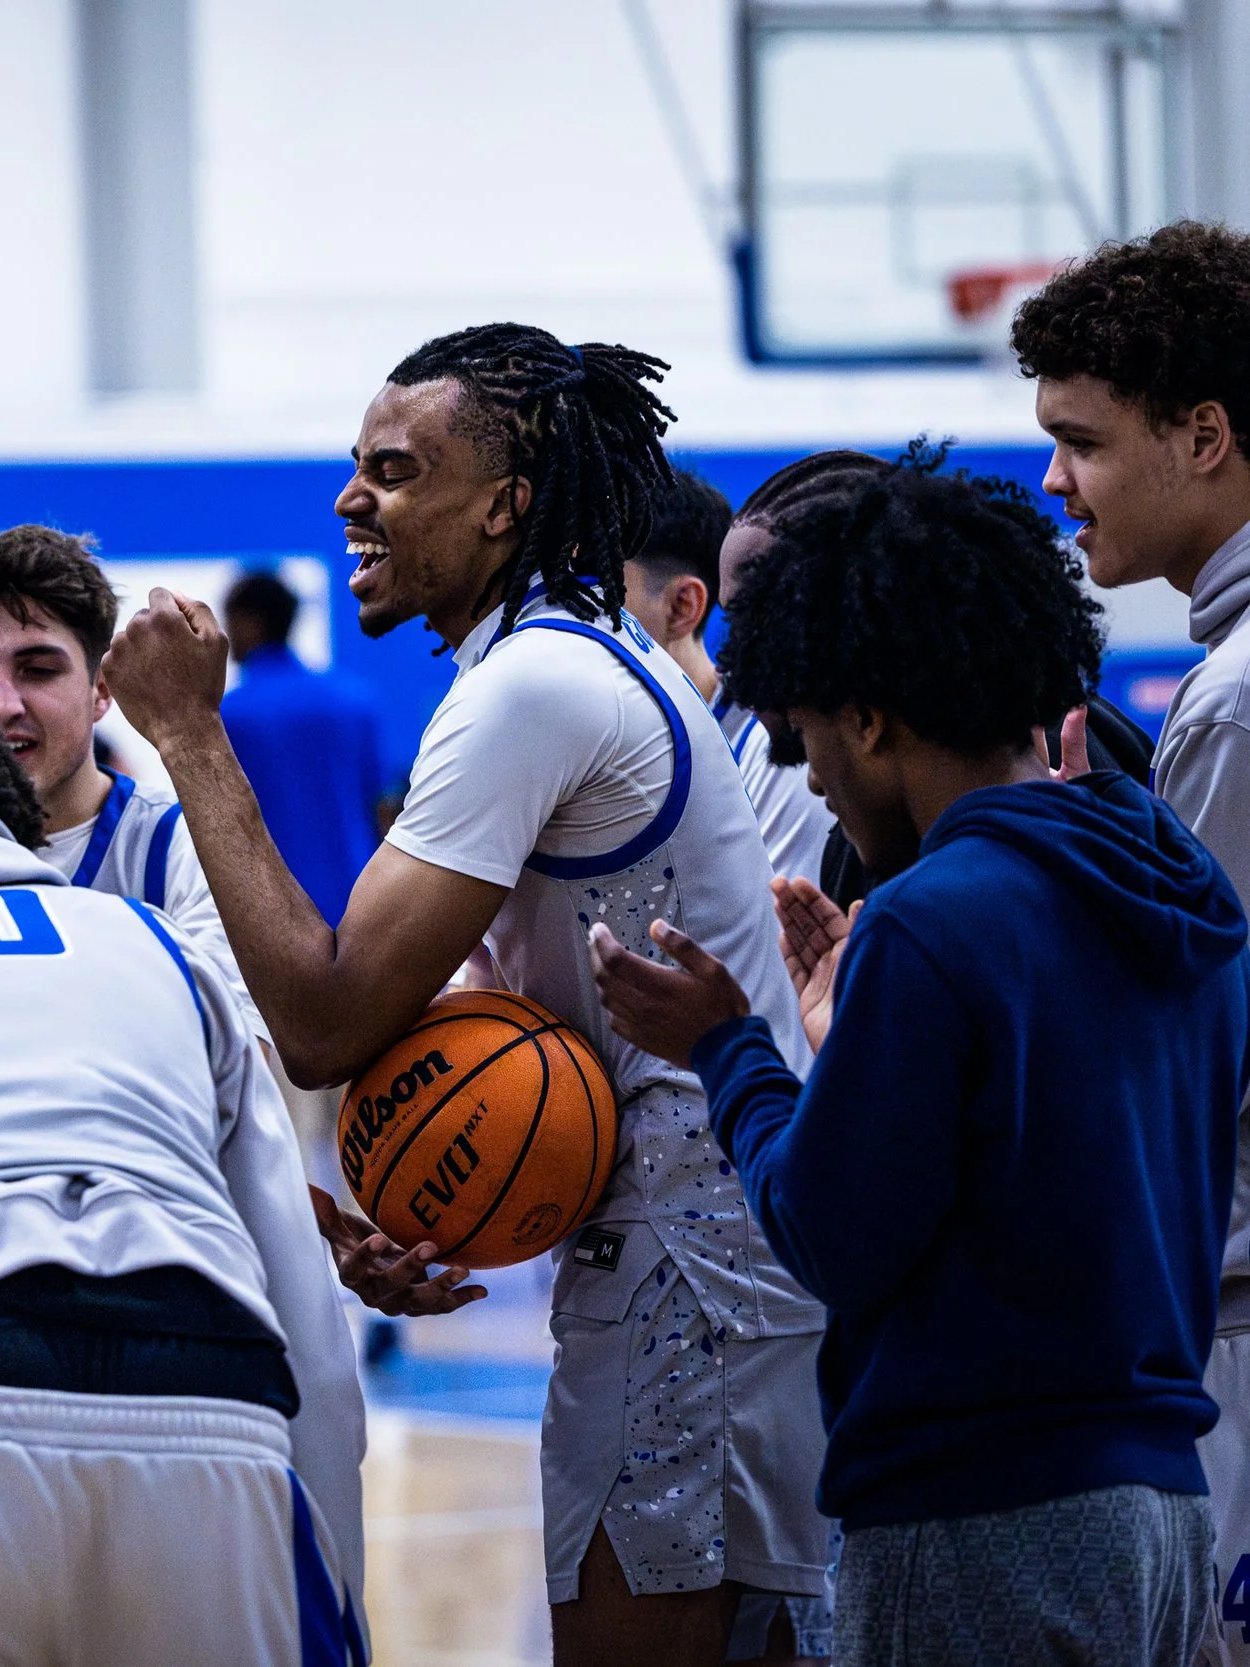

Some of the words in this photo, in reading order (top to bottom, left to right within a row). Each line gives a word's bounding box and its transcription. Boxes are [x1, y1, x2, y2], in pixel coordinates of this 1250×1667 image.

[342, 1050, 455, 1194] Wilson
[408, 1132, 481, 1231] EVO
[463, 1098, 489, 1137] NXT
[600, 1242, 614, 1259] M
[1213, 1553, 1250, 1645] 4
